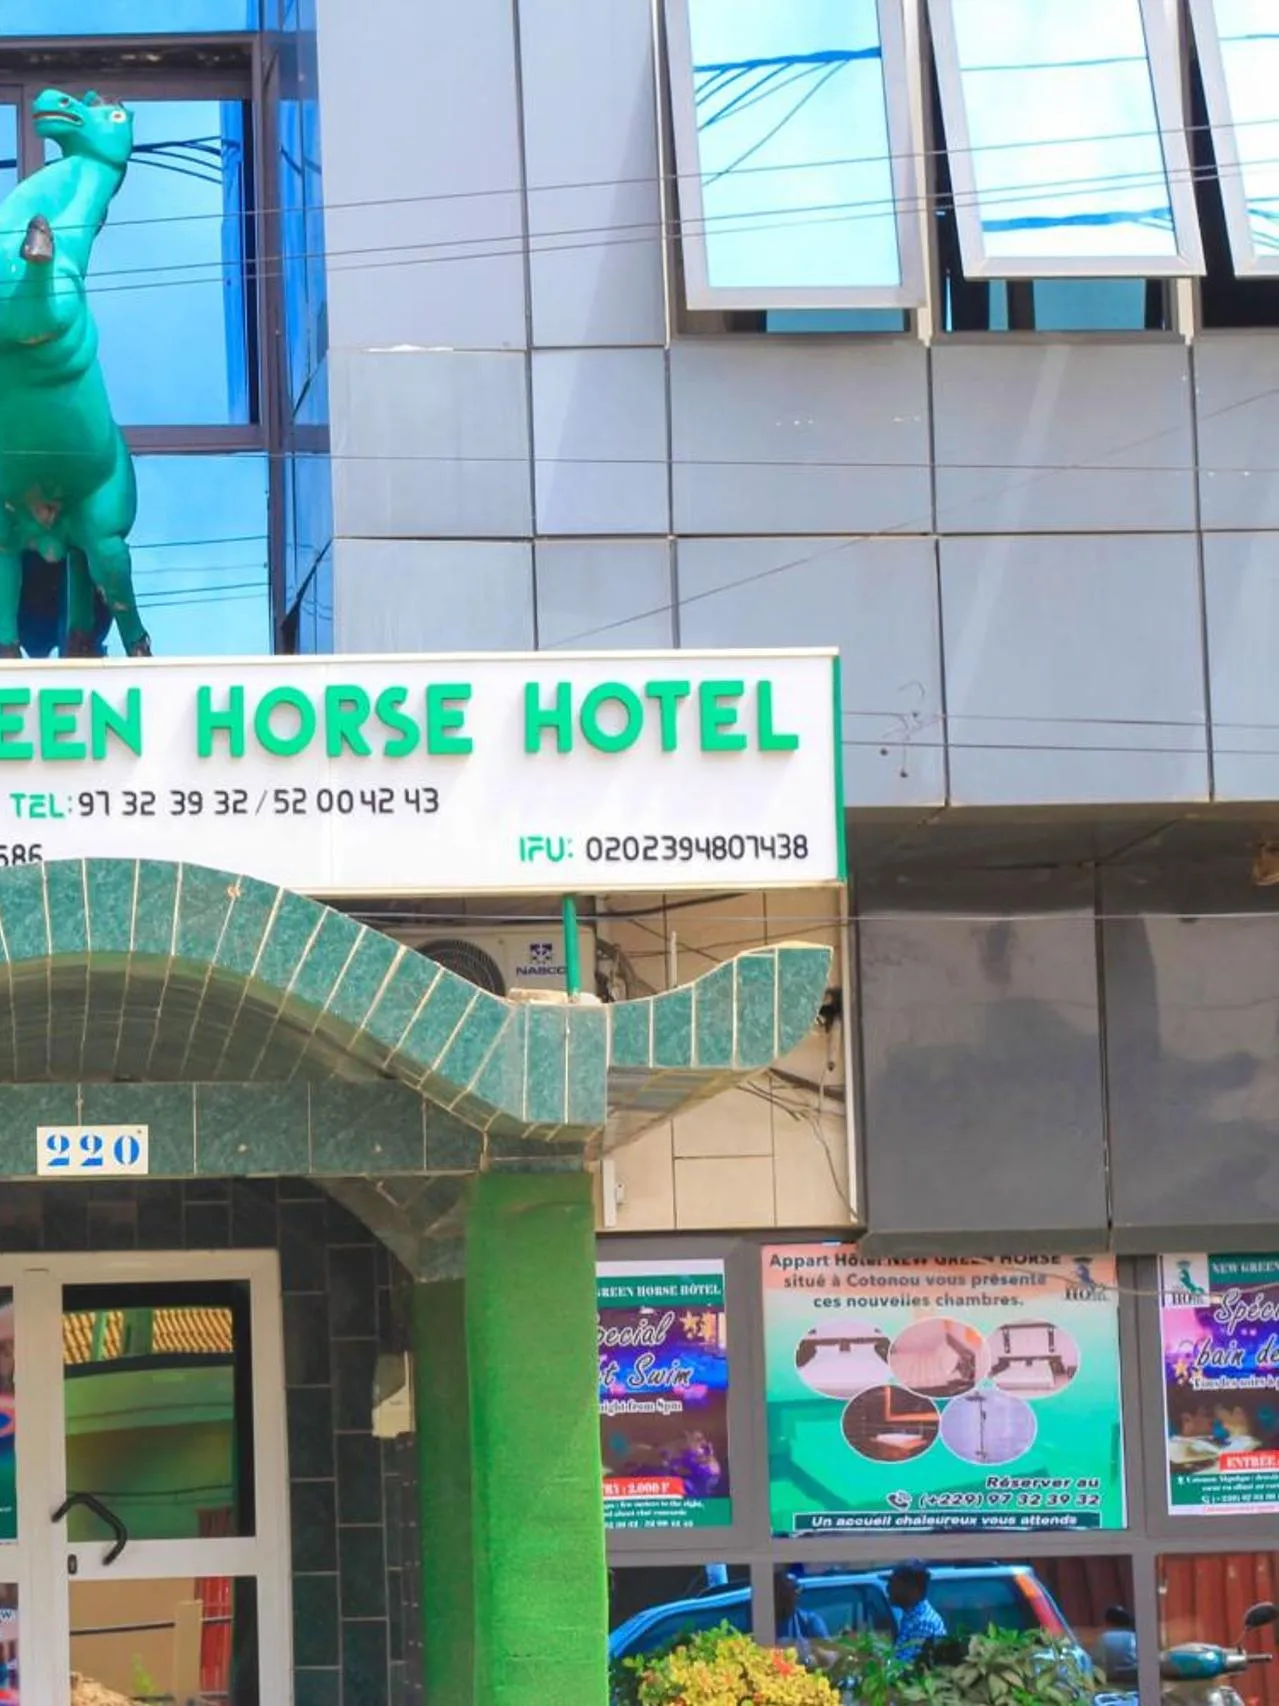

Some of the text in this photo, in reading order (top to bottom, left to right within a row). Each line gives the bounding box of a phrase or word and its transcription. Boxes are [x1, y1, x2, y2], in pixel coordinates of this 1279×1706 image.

[196, 682, 473, 761] HORSE
[524, 679, 800, 754] HOTEL
[122, 791, 156, 816] 32
[170, 790, 204, 816] 39
[404, 787, 439, 813] 43
[519, 834, 809, 862] IFU: 0202394807438
[47, 1134, 140, 1167] 220
[770, 1254, 829, 1270] Appart
[784, 1273, 825, 1288] situé
[847, 1274, 919, 1287] Cotonou
[926, 1276, 966, 1286] vous
[813, 1296, 841, 1307] ces
[1195, 1336, 1245, 1370] bain
[627, 1352, 695, 1388] Swim
[985, 1475, 1100, 1488] Réserver au
[988, 1493, 1011, 1506] 97
[1017, 1493, 1041, 1506] 32
[1047, 1493, 1070, 1506] 39
[1076, 1493, 1101, 1506] 32
[812, 1515, 832, 1527] Un
[982, 1515, 1015, 1526] vous
